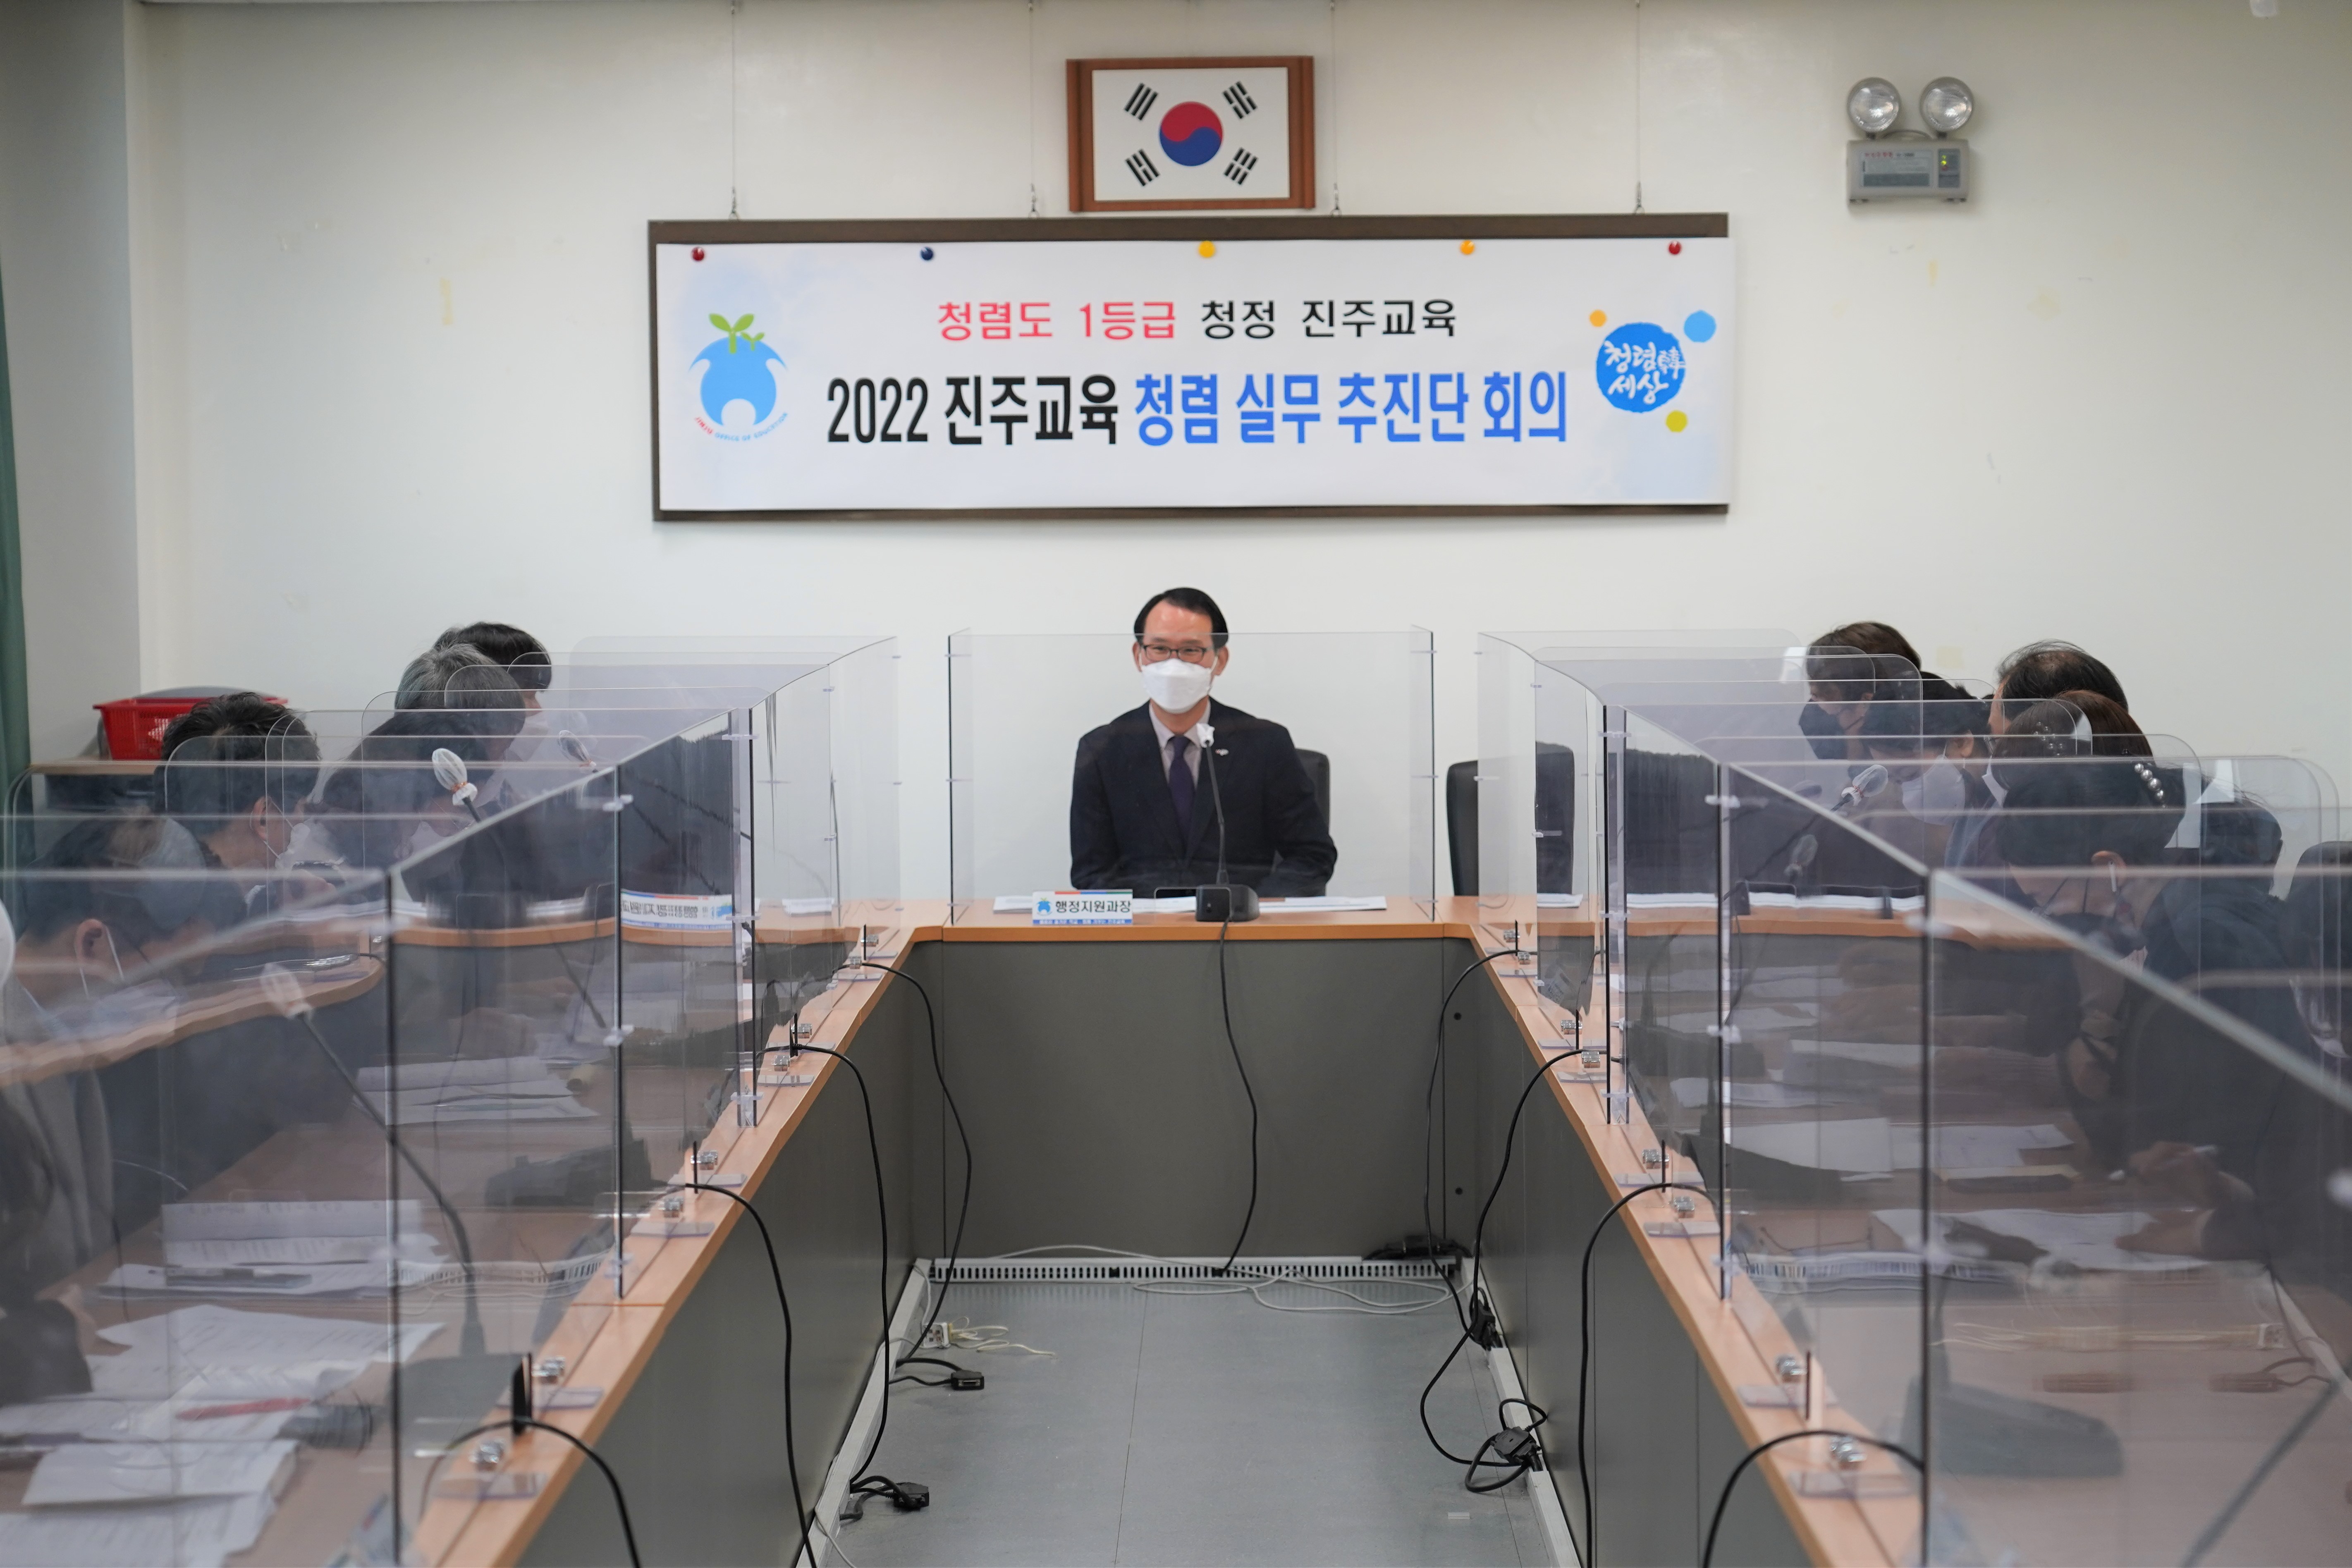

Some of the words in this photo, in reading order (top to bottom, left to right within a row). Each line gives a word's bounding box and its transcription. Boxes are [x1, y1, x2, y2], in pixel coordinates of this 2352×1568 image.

[939, 302, 1052, 341] 청렴도
[1080, 302, 1175, 340] 1등급
[1202, 300, 1275, 340] 청정
[1302, 299, 1456, 338] 진주교육
[1608, 370, 1669, 404] 세상
[827, 377, 928, 444] 2022
[944, 374, 1119, 446] 진주교육
[1135, 373, 1218, 447] 청렴
[1236, 373, 1321, 444] 실무
[1338, 372, 1469, 444] 추진단
[1484, 371, 1566, 442] 회의
[1055, 899, 1131, 913] 행정지원과장
